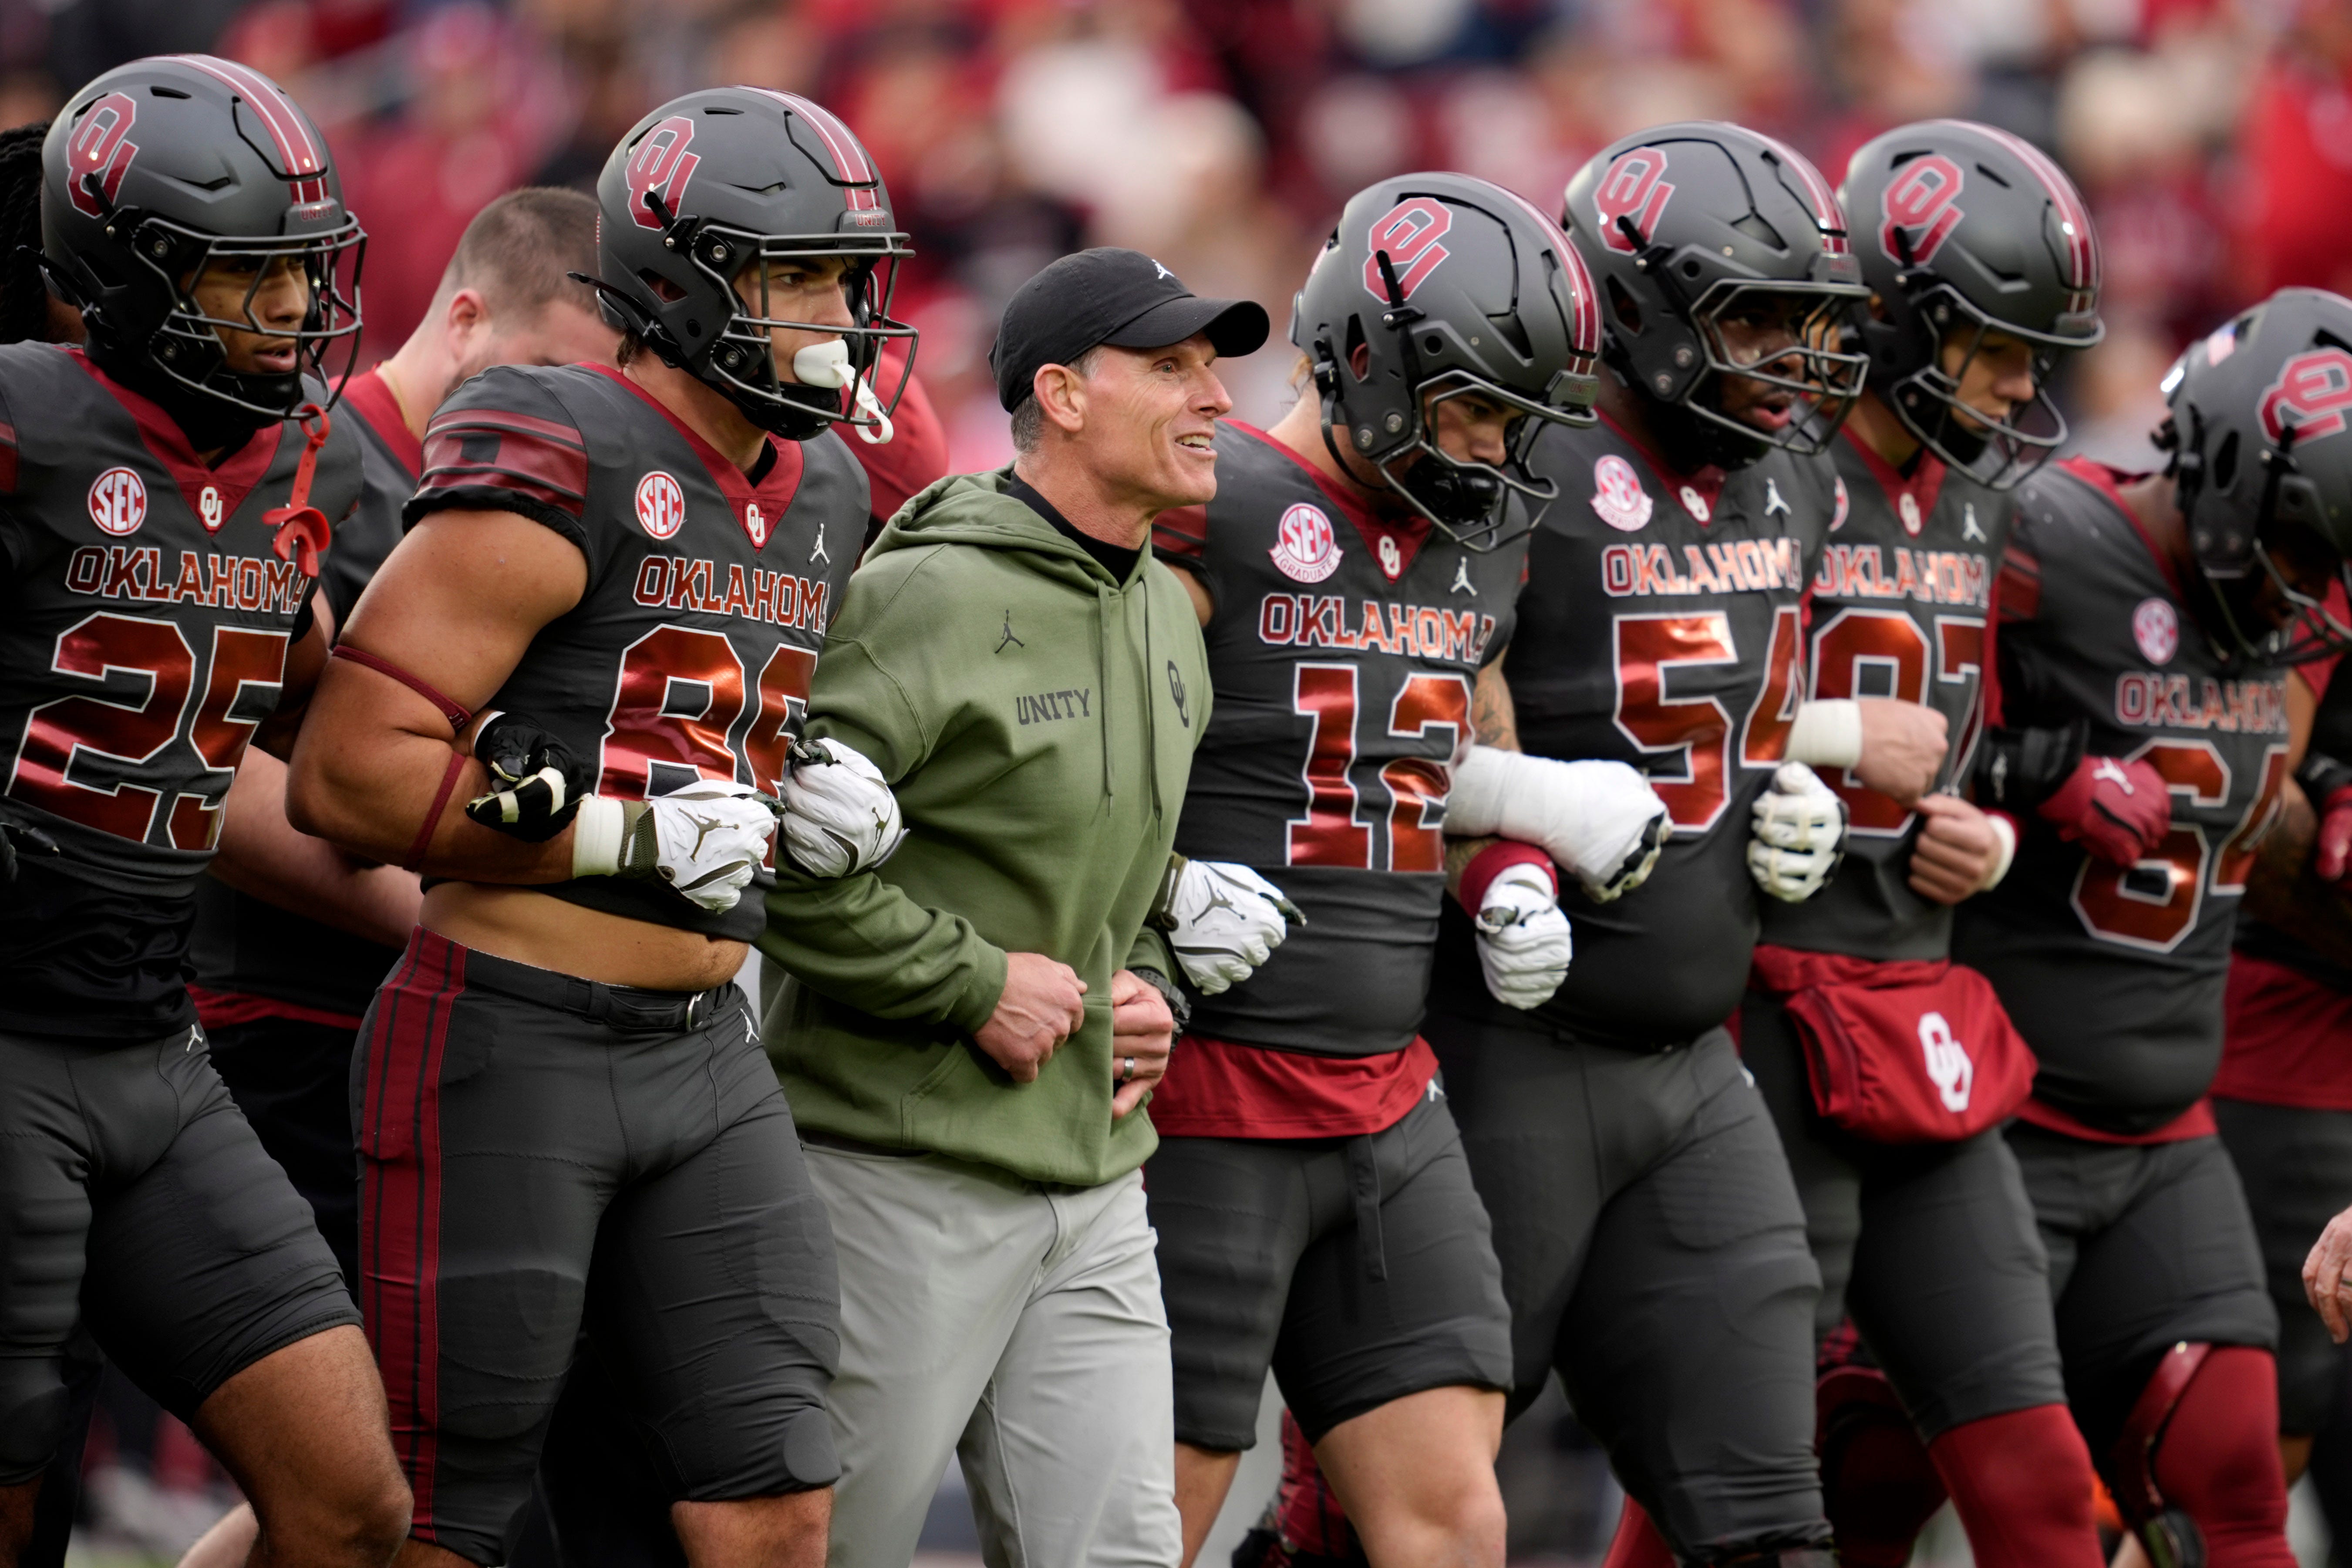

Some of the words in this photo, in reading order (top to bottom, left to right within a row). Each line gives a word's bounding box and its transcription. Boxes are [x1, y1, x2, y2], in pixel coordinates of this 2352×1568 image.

[66, 91, 139, 219] OU
[625, 116, 701, 231] OU
[300, 205, 333, 223] UNITY
[855, 214, 885, 226] UNITY
[1592, 146, 1675, 256] OU
[1879, 155, 1964, 268] OU
[1363, 197, 1452, 304] OU
[94, 470, 143, 533] SEC
[200, 486, 223, 527] OU
[639, 476, 682, 537] SEC
[747, 502, 765, 544] OU
[1679, 486, 1710, 523] OU
[1284, 508, 1328, 562] SEC
[1378, 536, 1400, 577] OU
[65, 545, 310, 614] OKLAHOMA
[1280, 559, 1335, 580] GRADUATE
[1259, 593, 1496, 664] OKLAHOMA
[1016, 688, 1090, 725] UNITY
[1167, 660, 1189, 728] OU
[1613, 606, 1806, 833] 54
[3, 610, 293, 850] 25
[1286, 663, 1476, 872] 12
